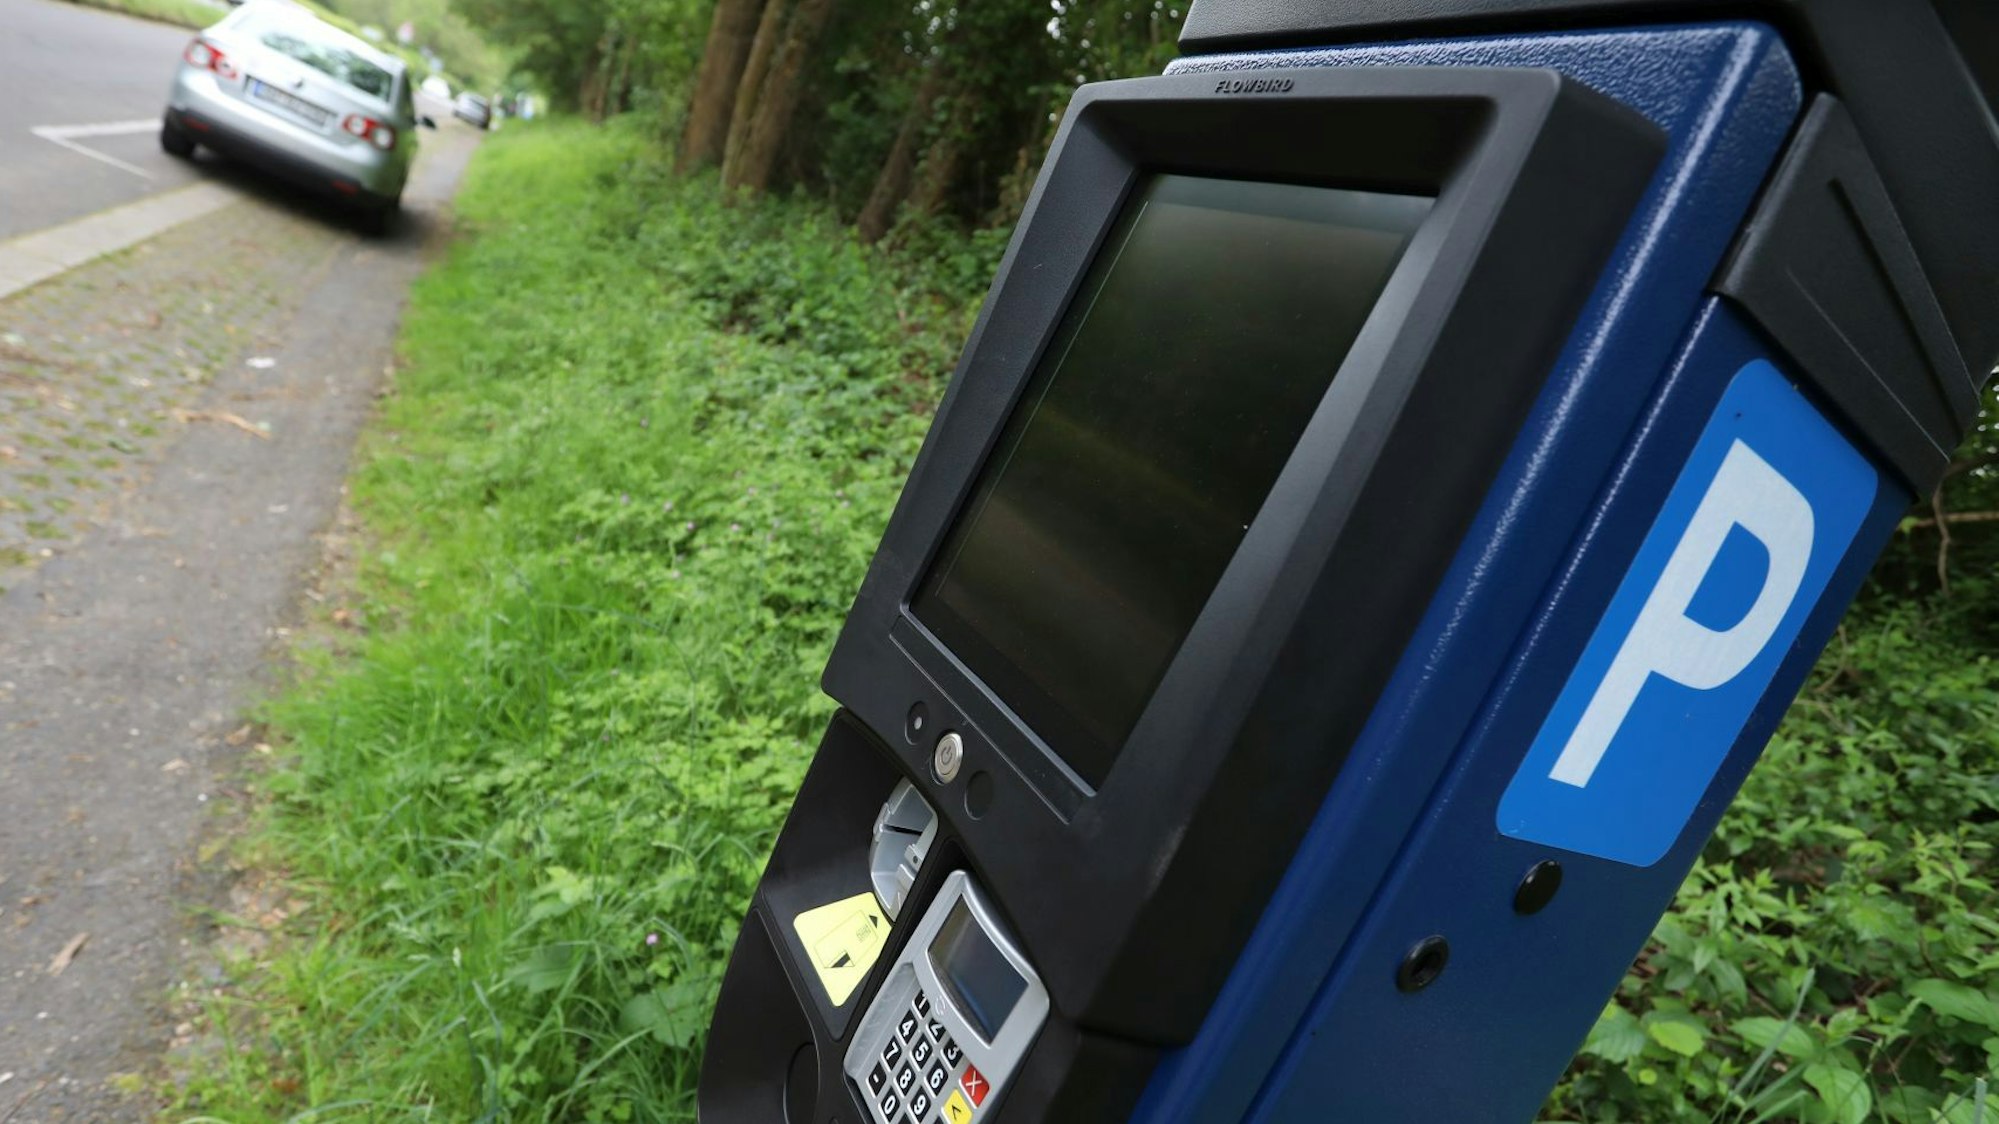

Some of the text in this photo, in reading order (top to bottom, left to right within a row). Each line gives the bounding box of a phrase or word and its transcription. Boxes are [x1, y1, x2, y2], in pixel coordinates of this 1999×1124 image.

[1214, 79, 1295, 94] FLOWBIRD
[1547, 437, 1815, 788] P
[886, 1041, 926, 1115] 7 8 9
[901, 1019, 944, 1089] 4 5 6
[884, 1095, 896, 1115] 0
